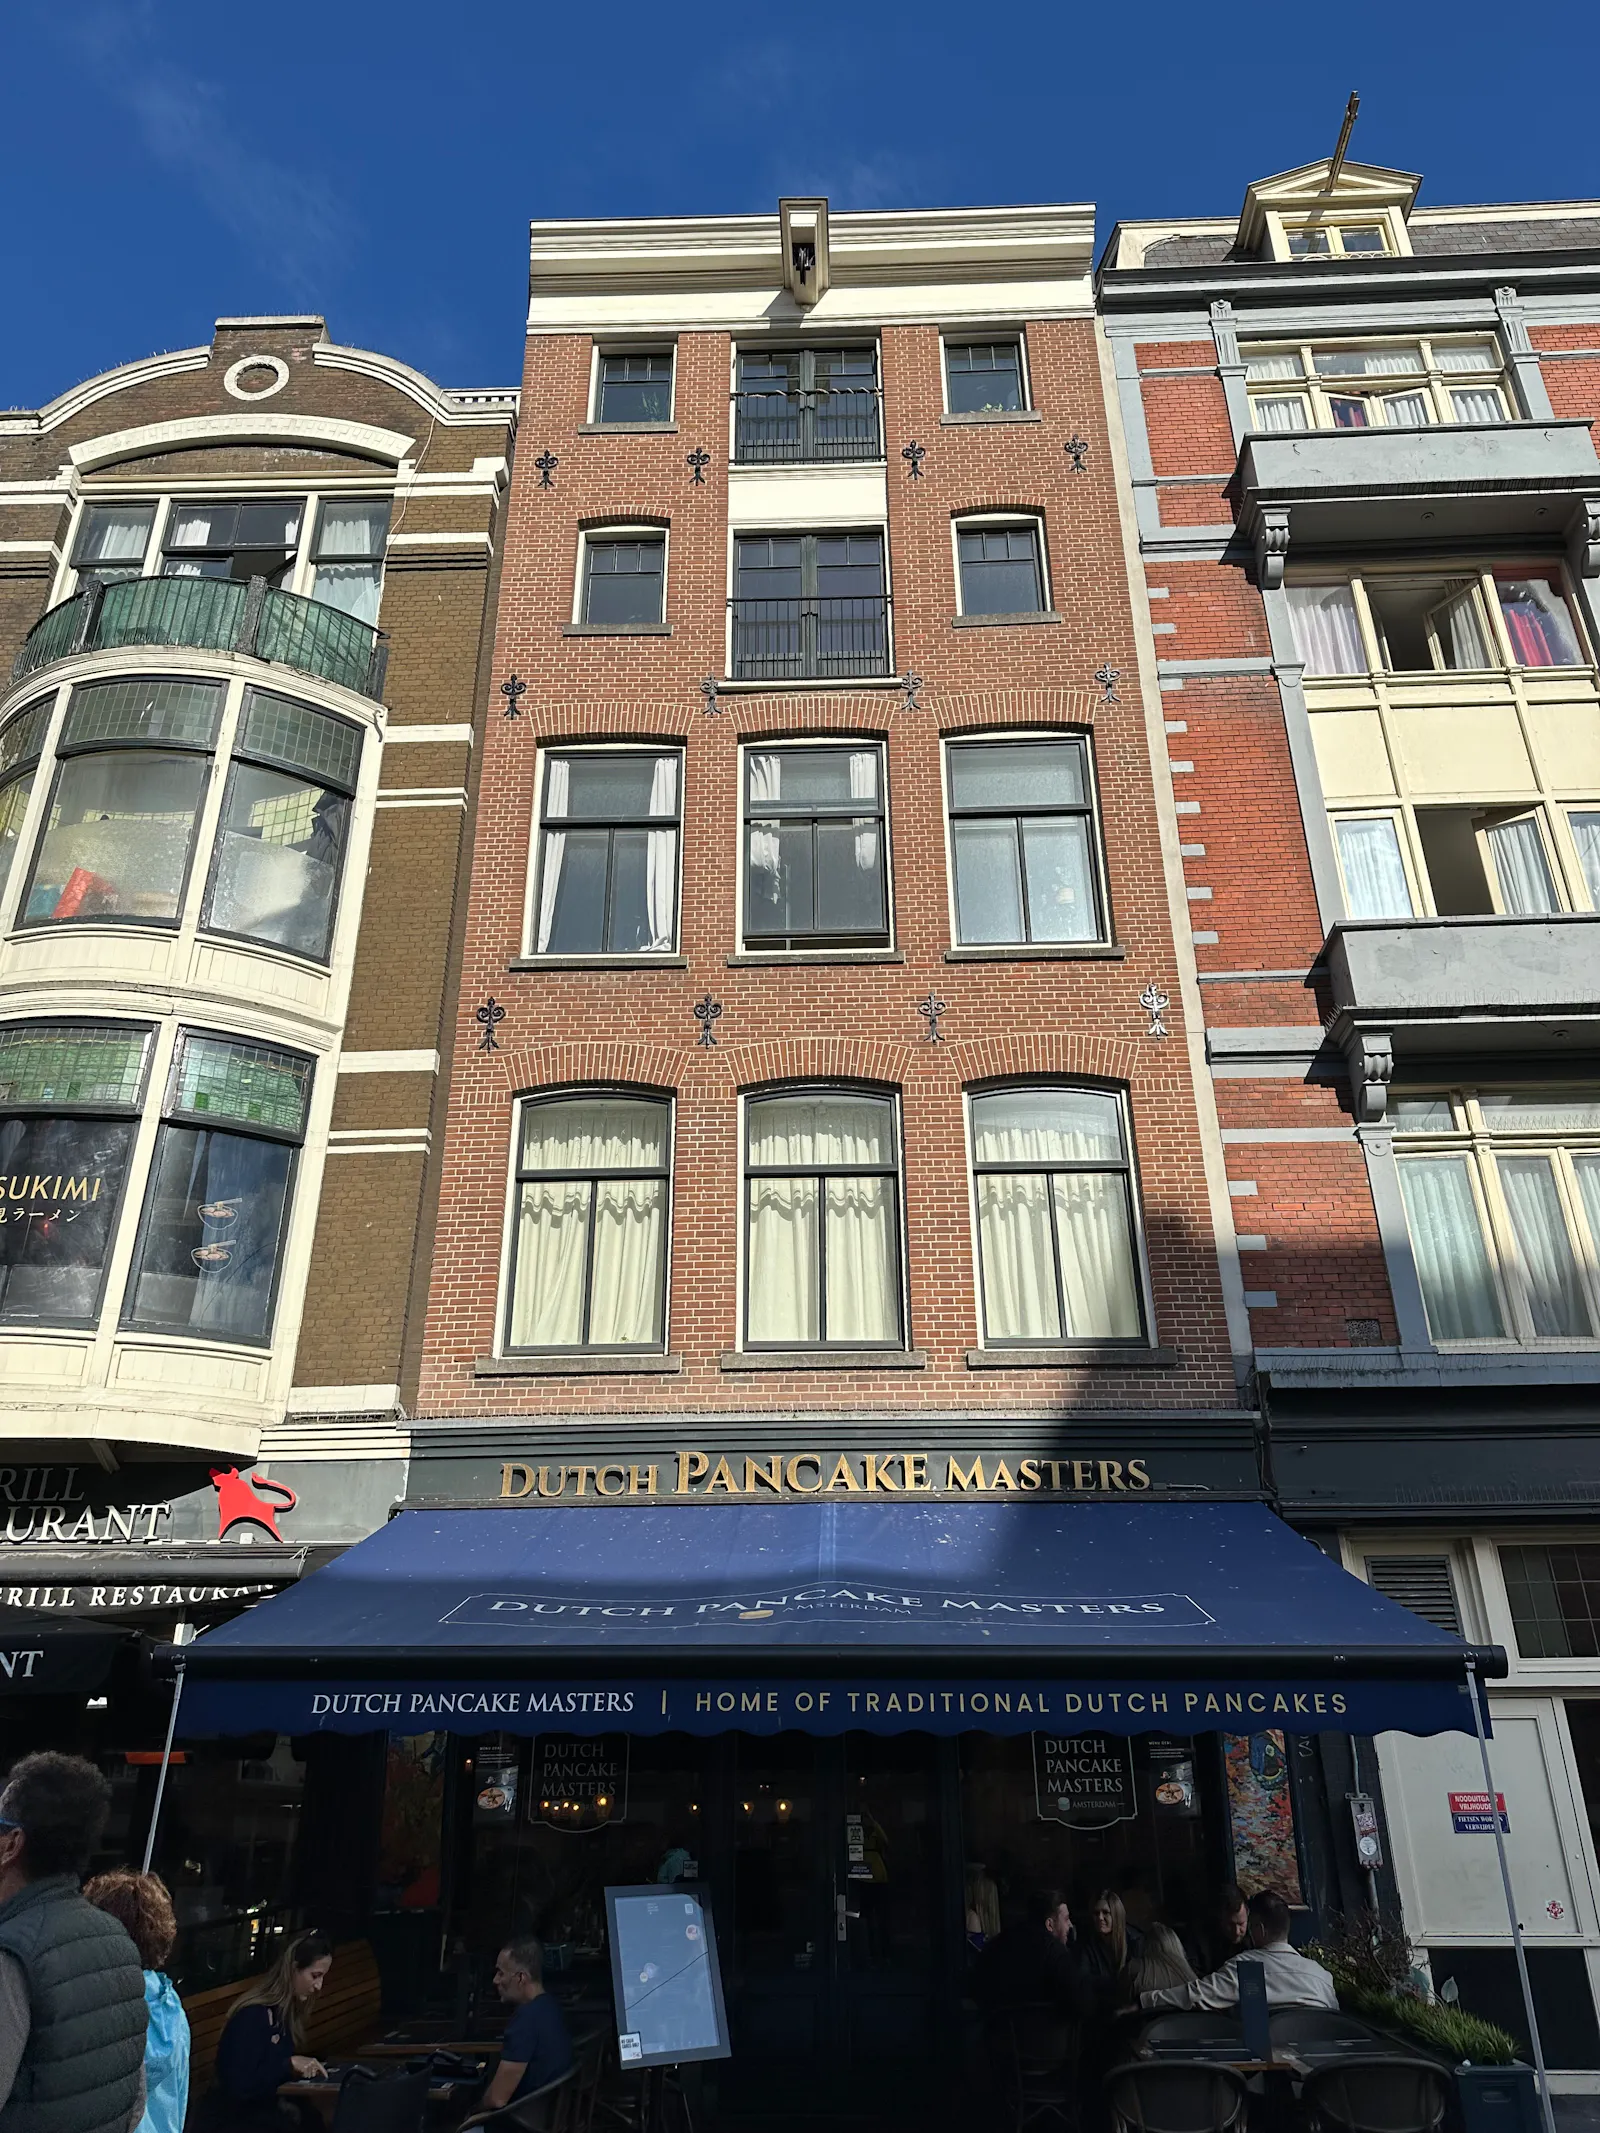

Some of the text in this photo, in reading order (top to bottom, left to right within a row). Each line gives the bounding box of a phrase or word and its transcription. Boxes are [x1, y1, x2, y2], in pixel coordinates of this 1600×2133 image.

[500, 1450, 1151, 1497] DUTCH PANCAKE MASTERS
[0, 1504, 170, 1542] URANT
[0, 1585, 274, 1607] RILL RESTAURA
[489, 1589, 1165, 1617] DUTCH PANCAKE MASTERS
[782, 1602, 912, 1615] AMSTERDAM
[311, 1693, 402, 1714] DUTCH
[409, 1692, 520, 1713] PANCAKE
[525, 1692, 634, 1712] MASTERS
[696, 1692, 779, 1712] HOME
[795, 1692, 831, 1712] OF
[848, 1692, 1050, 1713] TRADITIONAL
[1065, 1693, 1168, 1713] DUTCH
[1185, 1693, 1347, 1714] PANCAKES
[544, 1744, 604, 1758] DUTCH
[1044, 1740, 1106, 1754] DUTCH
[543, 1763, 618, 1777] PANCAKE
[1046, 1758, 1123, 1773] PANCAKE
[541, 1781, 616, 1796] MASTERS
[1047, 1777, 1124, 1793] MASTERS
[1072, 1800, 1116, 1809] AMSTERDAM
